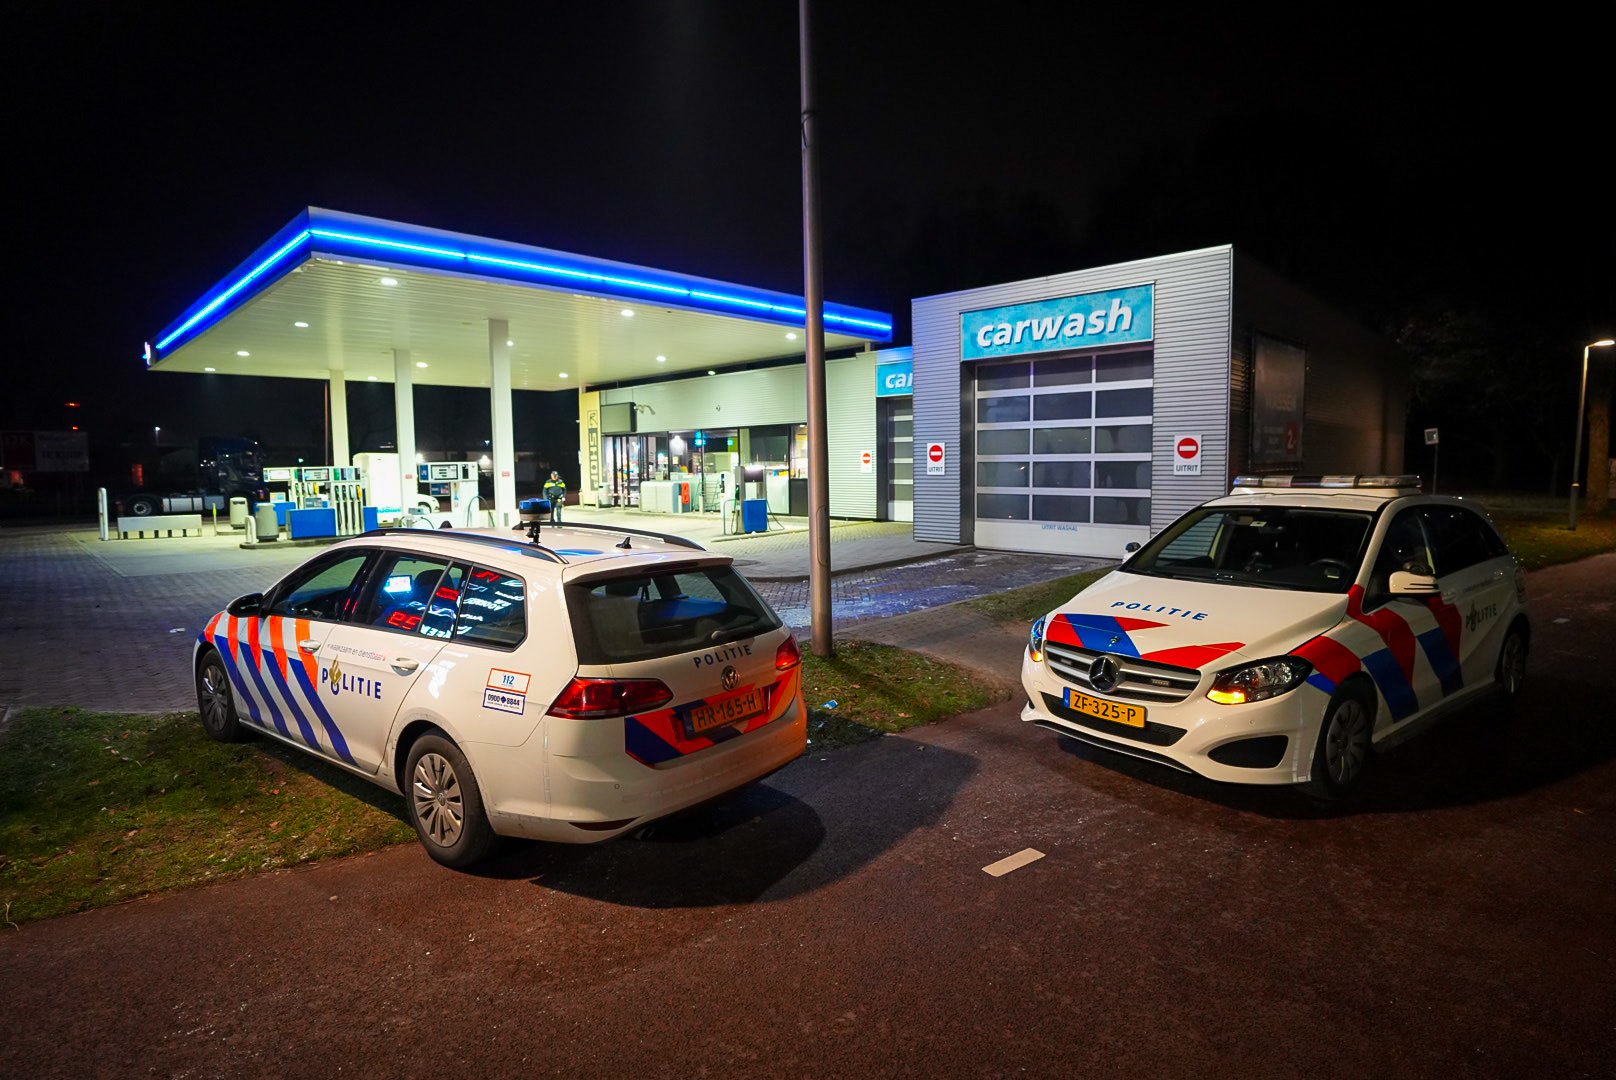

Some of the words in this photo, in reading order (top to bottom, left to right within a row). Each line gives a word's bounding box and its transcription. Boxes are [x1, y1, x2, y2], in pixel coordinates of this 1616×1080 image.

[977, 298, 1134, 348] carwash
[1175, 464, 1199, 472] UITRIT
[1110, 601, 1208, 621] POLITIE
[1465, 602, 1497, 632] POLITIE
[692, 644, 752, 669] POLITIE
[321, 666, 382, 700] POLITIE
[502, 674, 515, 685] 112
[487, 693, 501, 702] 0900
[506, 697, 520, 706] 8844
[695, 692, 757, 728] HR-165-H
[1074, 694, 1136, 722] ZF-325-P
